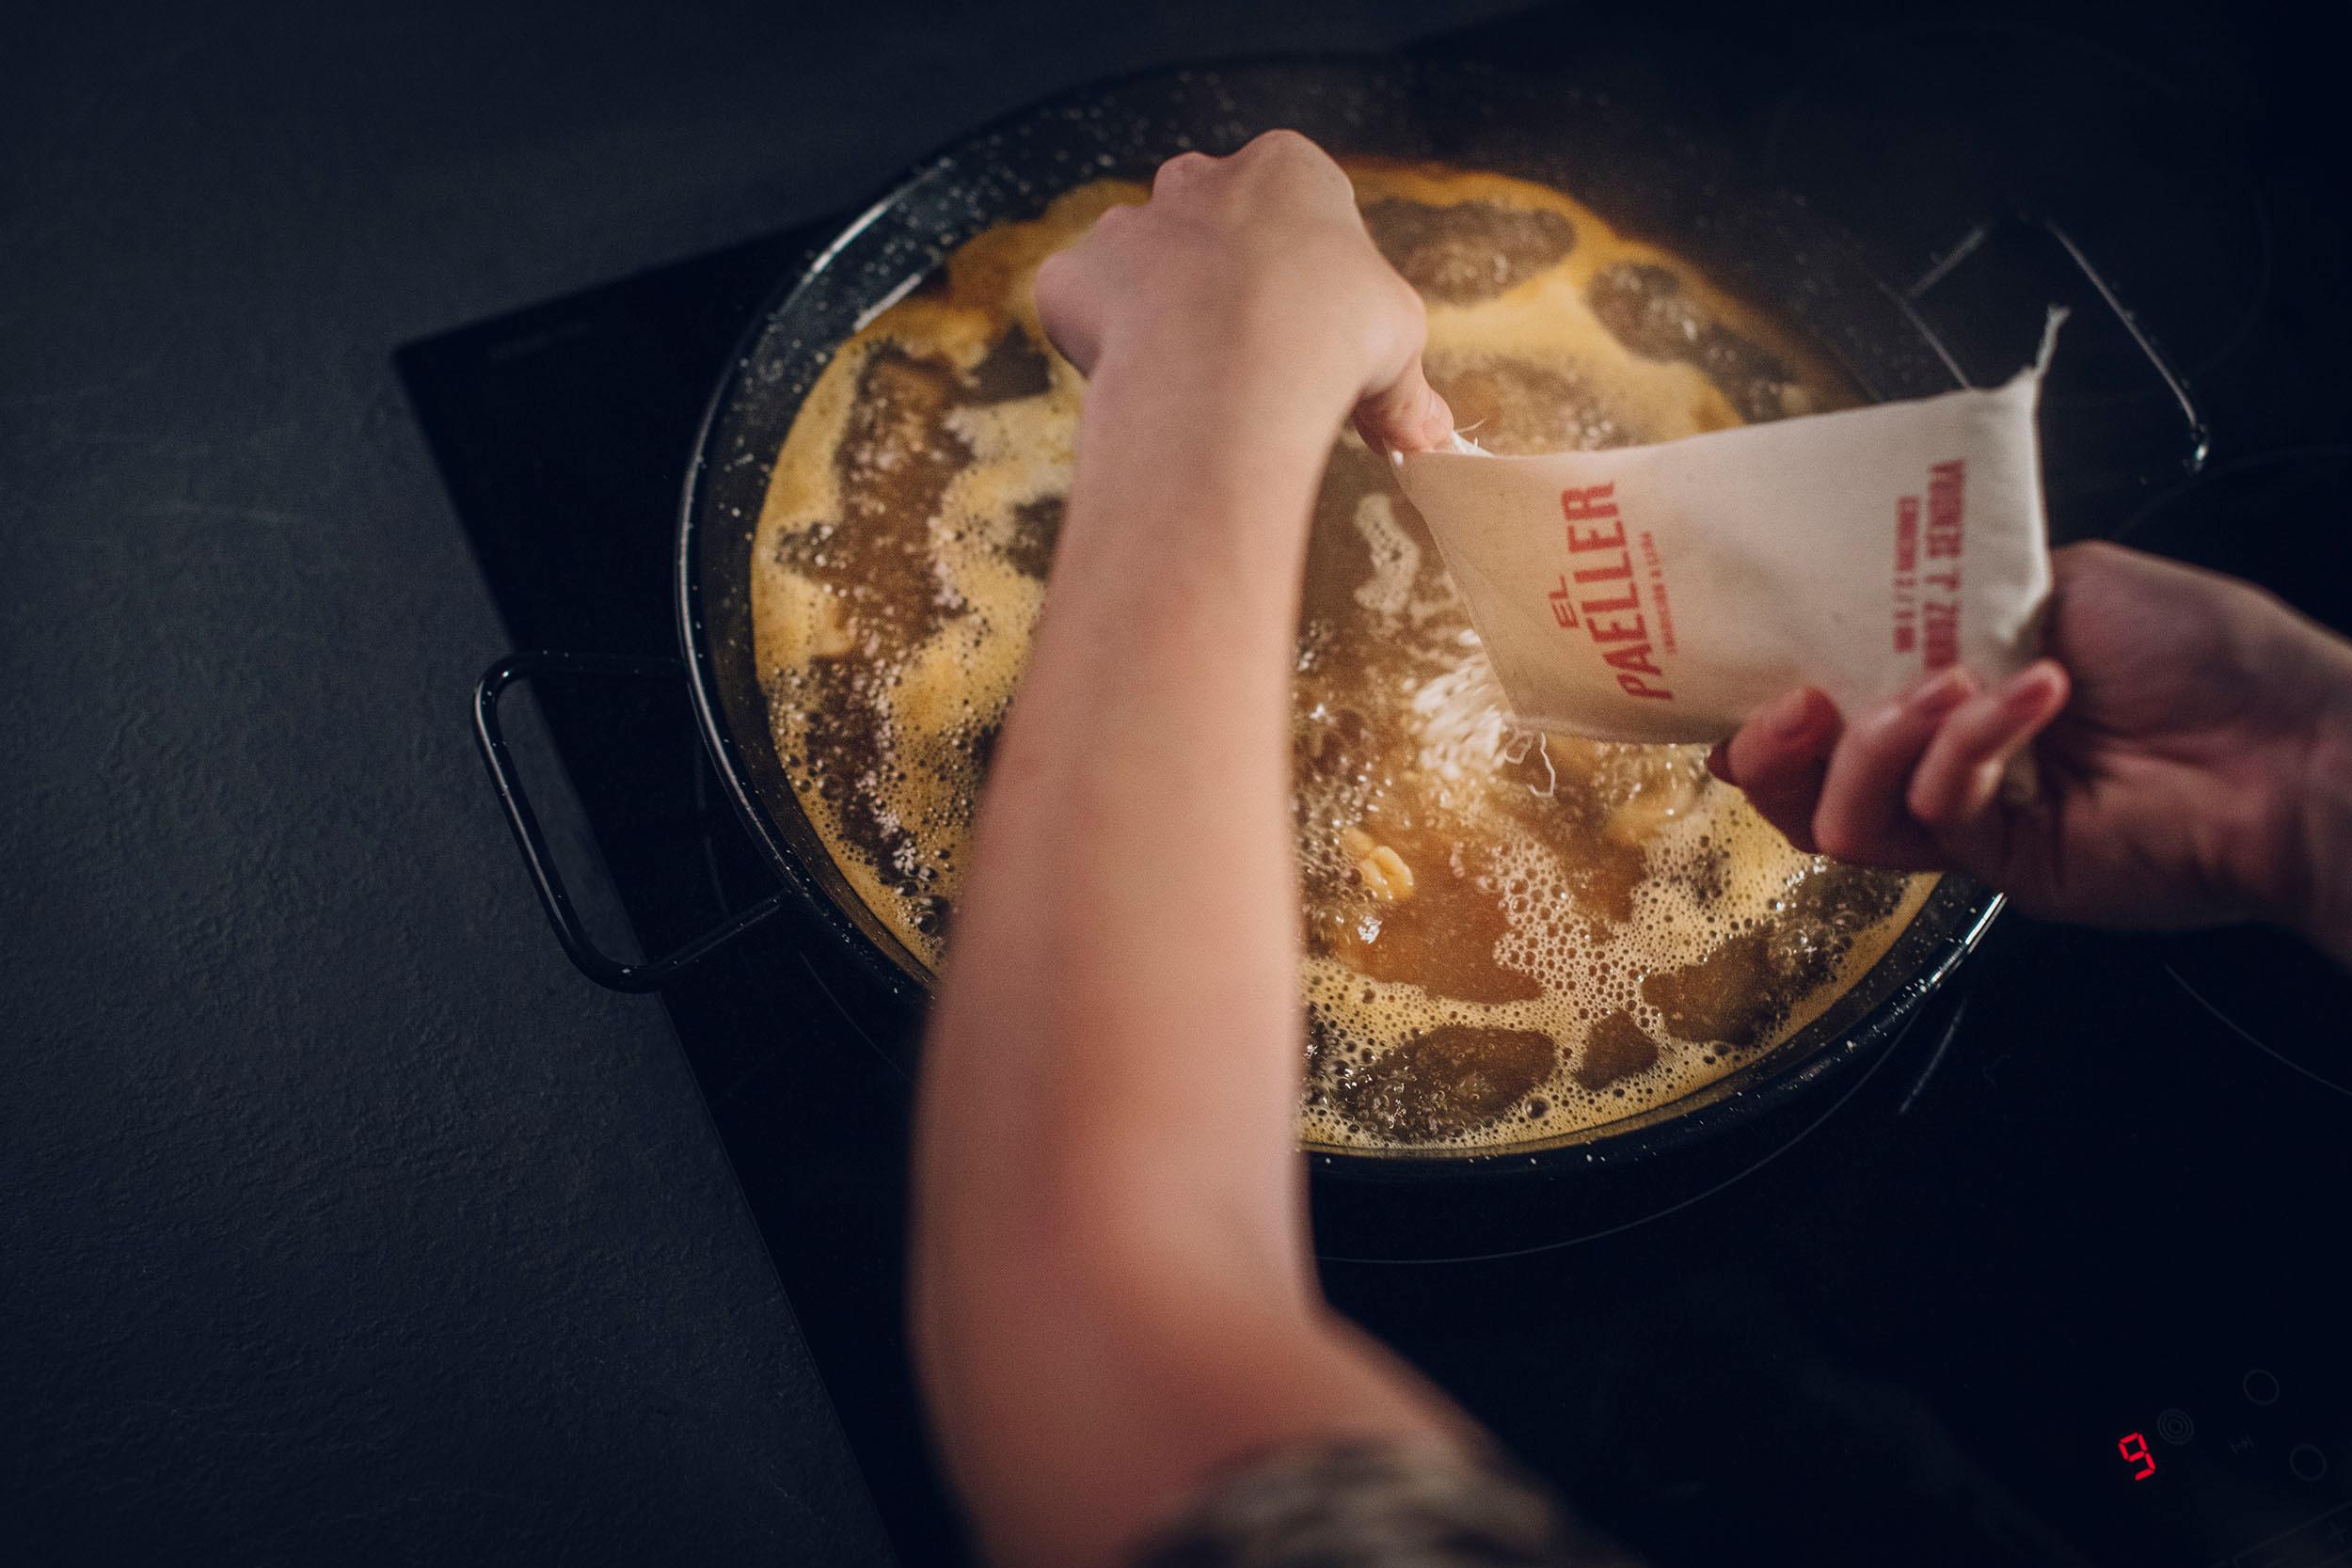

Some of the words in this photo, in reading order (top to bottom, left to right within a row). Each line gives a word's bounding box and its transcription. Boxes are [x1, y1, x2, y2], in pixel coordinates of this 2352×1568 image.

[1548, 575, 1579, 628] EL
[1562, 482, 1673, 700] PAELLER
[2118, 1432, 2156, 1481] 9
